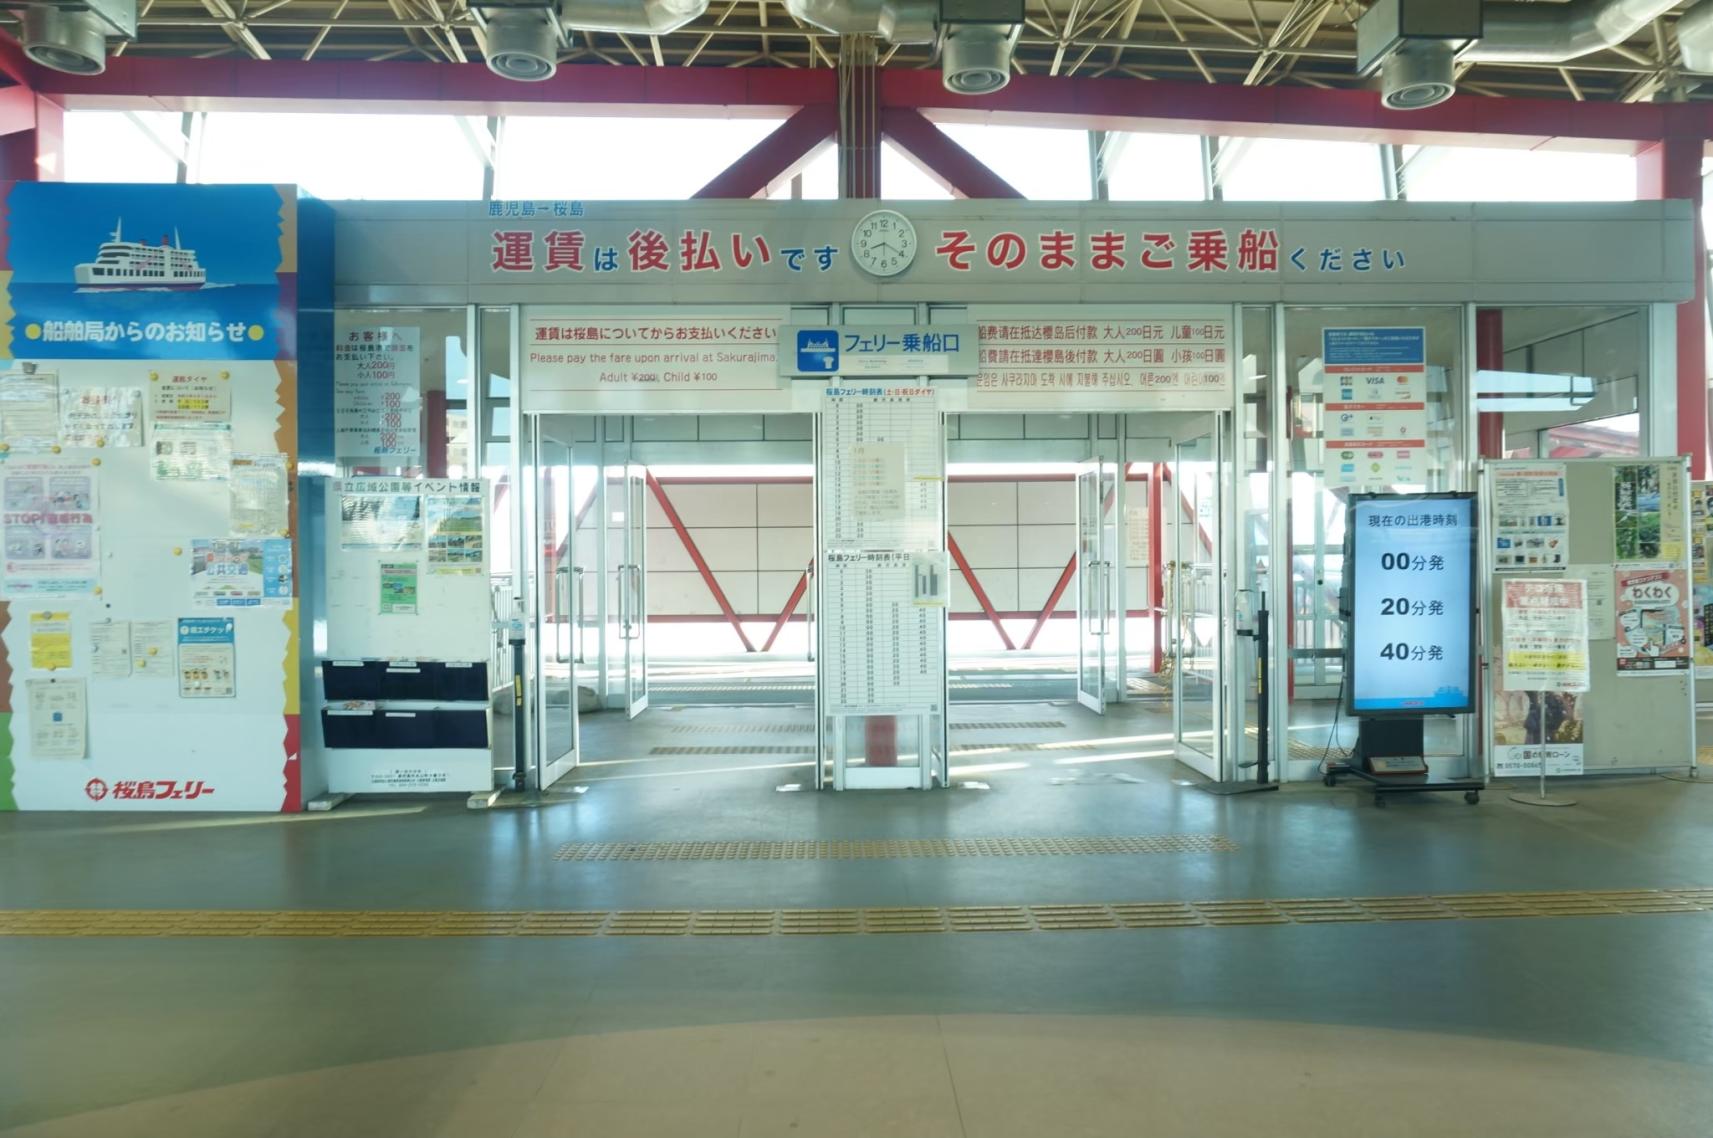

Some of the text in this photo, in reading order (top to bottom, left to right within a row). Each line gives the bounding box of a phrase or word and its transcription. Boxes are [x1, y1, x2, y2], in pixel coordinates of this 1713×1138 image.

[880, 219, 888, 228] 12
[863, 229, 872, 237] 10
[898, 229, 904, 238] 2
[860, 239, 867, 248] 9
[901, 239, 907, 248] 3
[935, 228, 1405, 272] そのままご乗船ください
[493, 230, 838, 272] 運賃は後払いです
[863, 249, 870, 258] 8
[871, 256, 877, 265] 7
[880, 259, 887, 268] 6
[891, 256, 897, 265] 5
[42, 321, 245, 342] 船舶局からのお知らせ
[535, 326, 777, 340] 運賃は桜島についてからお支払いください
[1103, 324, 1163, 339] 大人200日元
[844, 333, 959, 353] フェリー乗船口
[530, 352, 564, 363] Please
[567, 354, 586, 365] pay
[590, 352, 606, 363] the
[609, 352, 632, 363] fare
[634, 353, 660, 365] upon
[663, 352, 699, 363] arrival
[703, 352, 713, 362] at
[600, 372, 628, 382] Adult
[664, 372, 690, 382] Child
[694, 373, 718, 382] ¥100
[1366, 376, 1385, 385] VISA
[1367, 513, 1458, 527] 現在の出港時刻
[1381, 552, 1445, 571] 00分発
[1632, 586, 1672, 599] わくわく
[1380, 597, 1444, 616] 20分発
[1379, 642, 1444, 661] 40分発
[111, 780, 215, 800] 桜島フェリー
